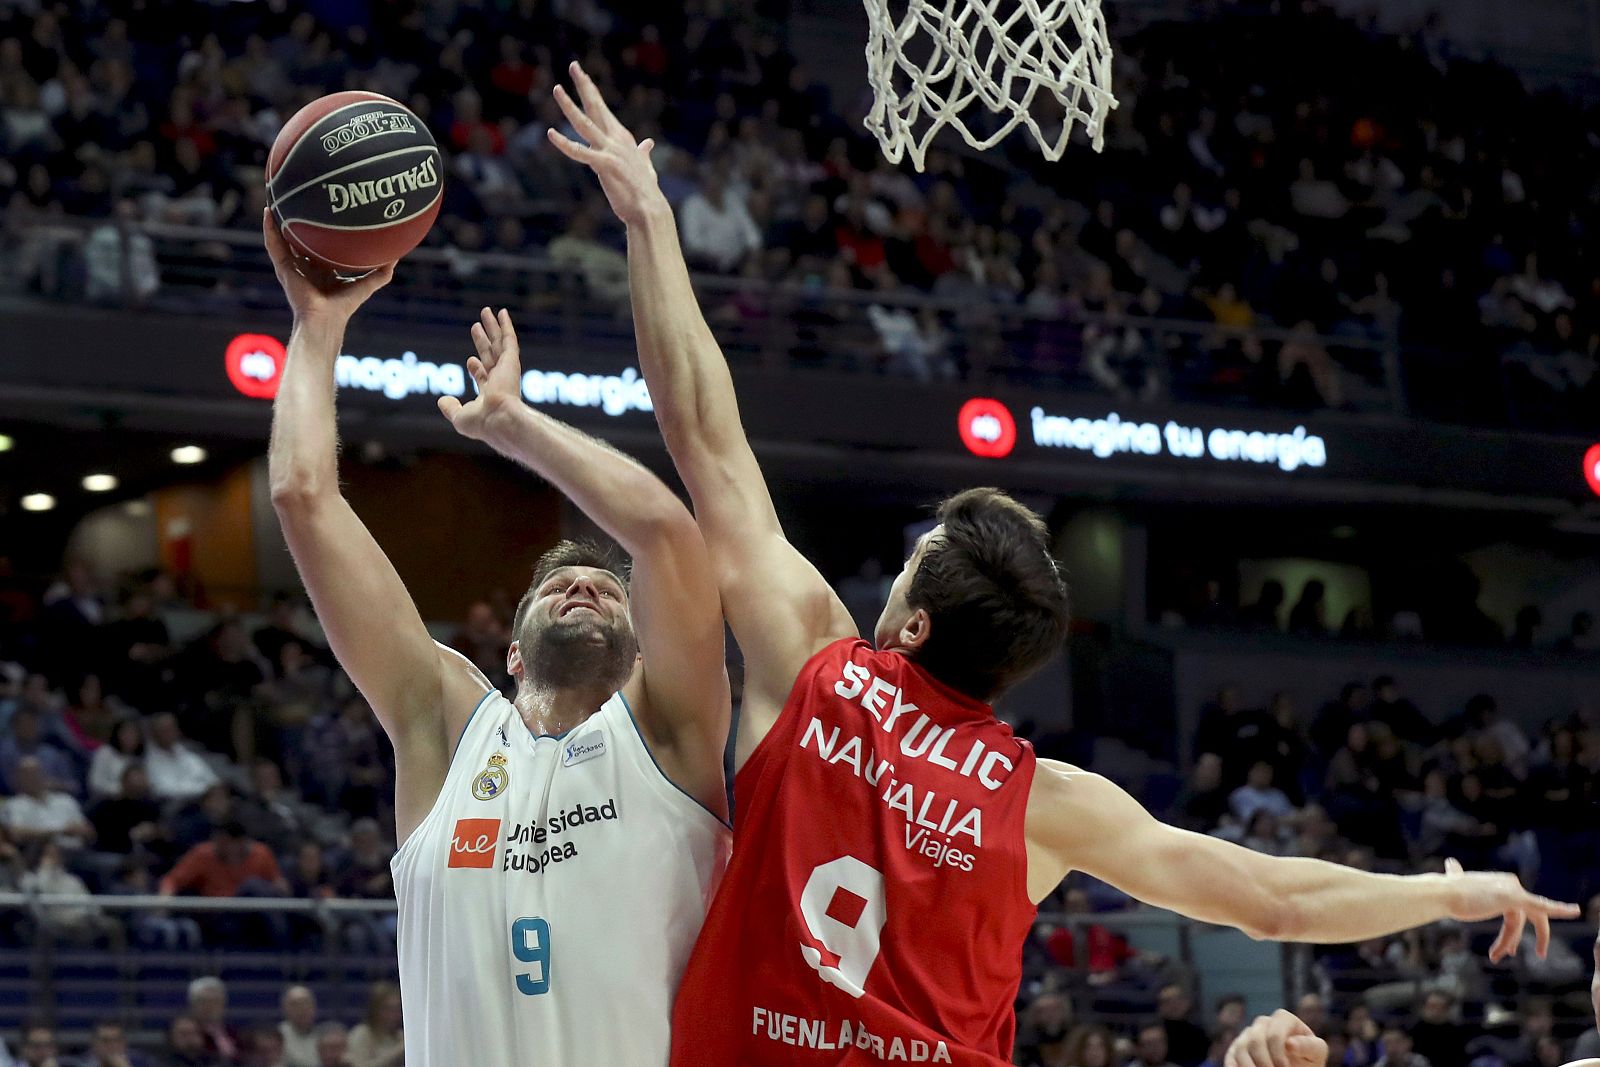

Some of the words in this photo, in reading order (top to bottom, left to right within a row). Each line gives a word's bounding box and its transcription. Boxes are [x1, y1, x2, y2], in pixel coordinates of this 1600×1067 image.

[327, 154, 438, 214] SPALDING
[334, 351, 465, 400] magina
[1030, 405, 1162, 458] imagina
[1163, 420, 1204, 458] tu
[906, 823, 976, 872] Viajes
[800, 855, 887, 999] 9
[512, 917, 551, 995] 9
